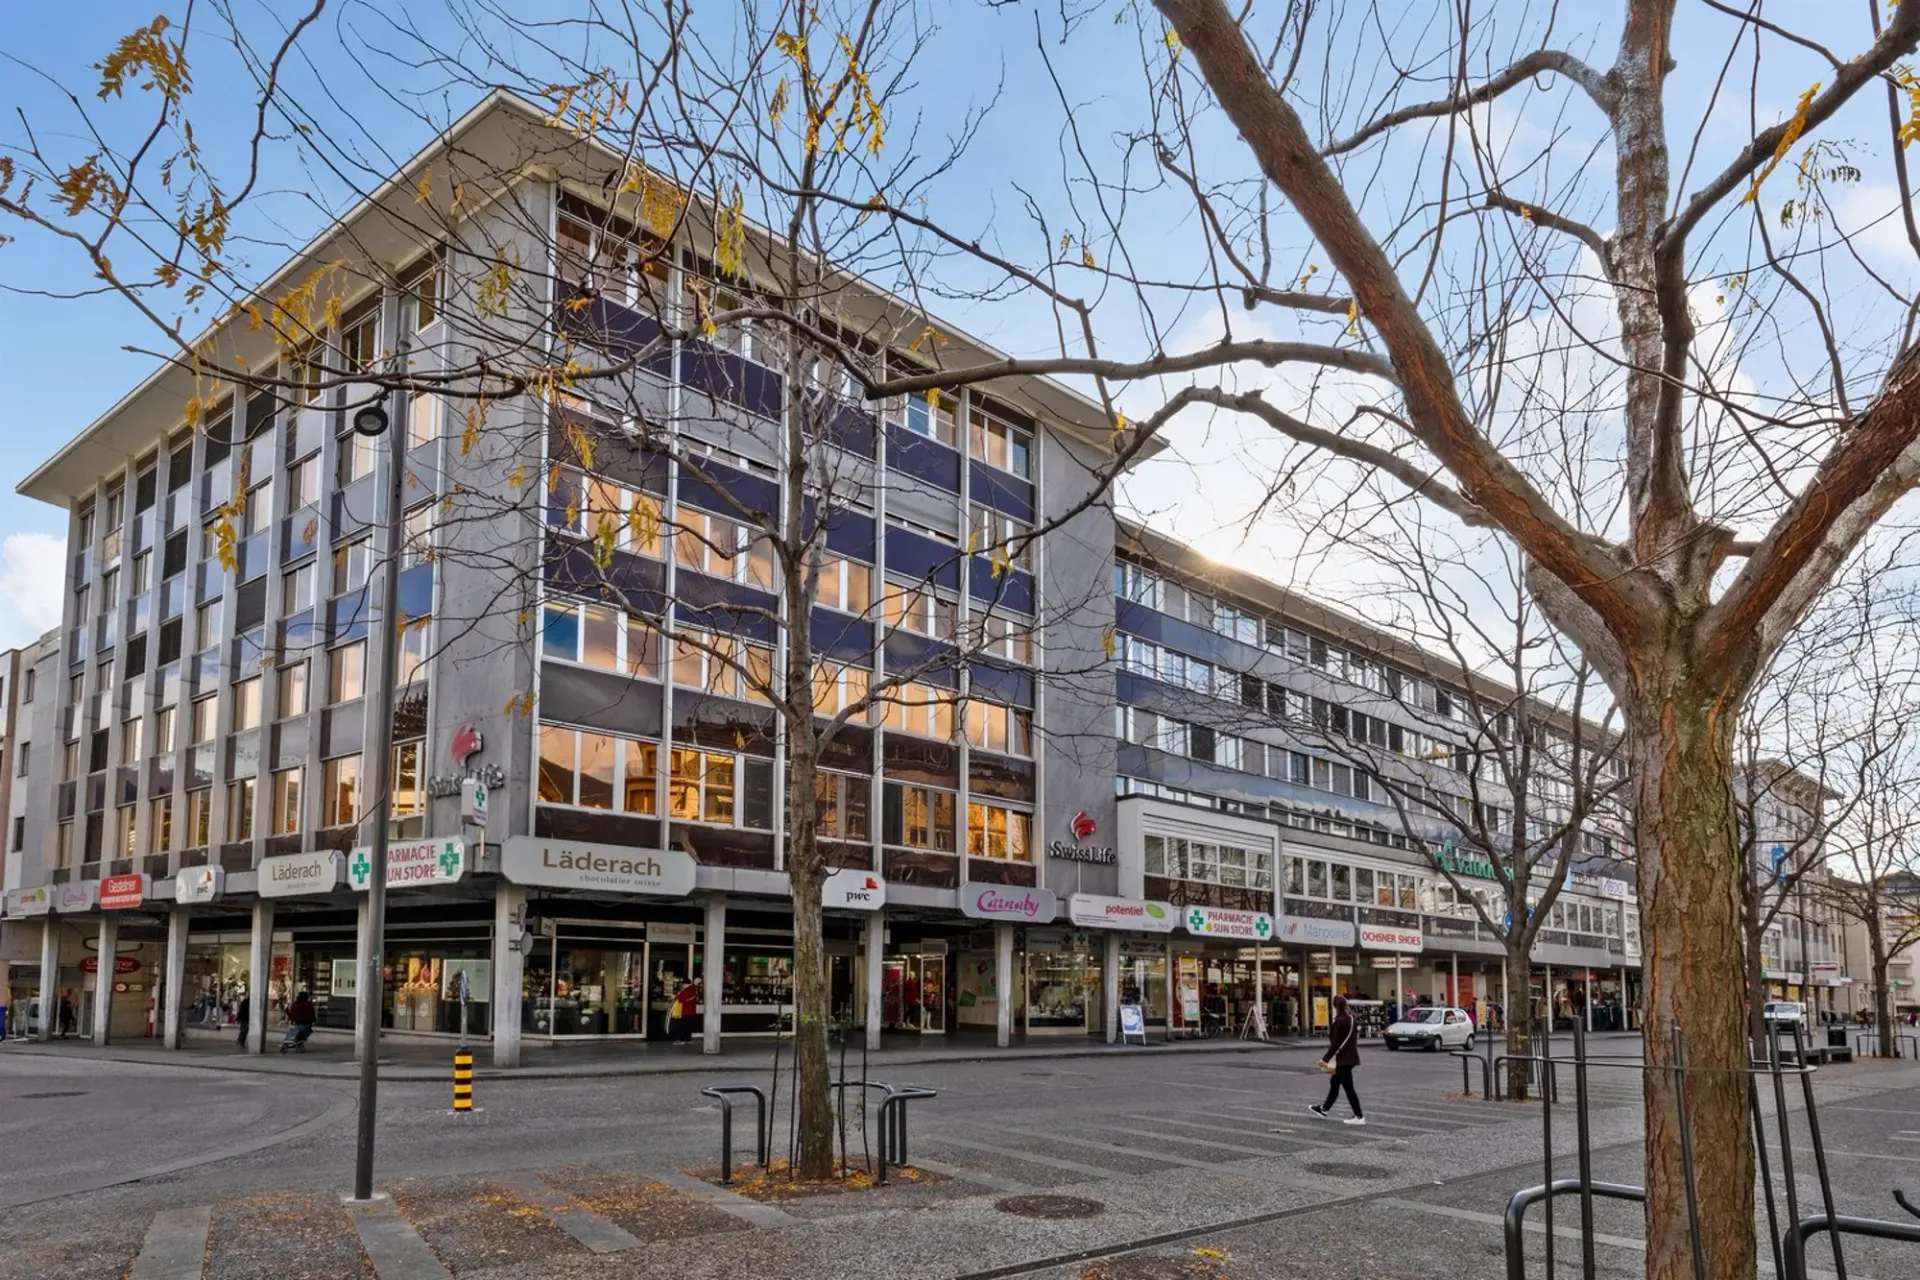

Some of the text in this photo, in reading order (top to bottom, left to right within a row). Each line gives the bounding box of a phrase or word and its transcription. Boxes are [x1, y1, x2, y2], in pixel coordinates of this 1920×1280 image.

[387, 845, 436, 862] ARMACIE
[272, 860, 321, 881] Läderach
[543, 849, 661, 876] Läderach
[387, 864, 436, 881] UN STORE
[579, 874, 661, 887] chocolatier suisse
[846, 891, 870, 901] pwc
[976, 890, 1040, 917] Carnaby
[1105, 903, 1144, 916] potentiel
[1208, 911, 1253, 924] PHARMACIE
[1213, 924, 1253, 936] SUN STORE
[1304, 923, 1350, 941] Manpower
[1362, 931, 1421, 946] OCHSNER SHOES
